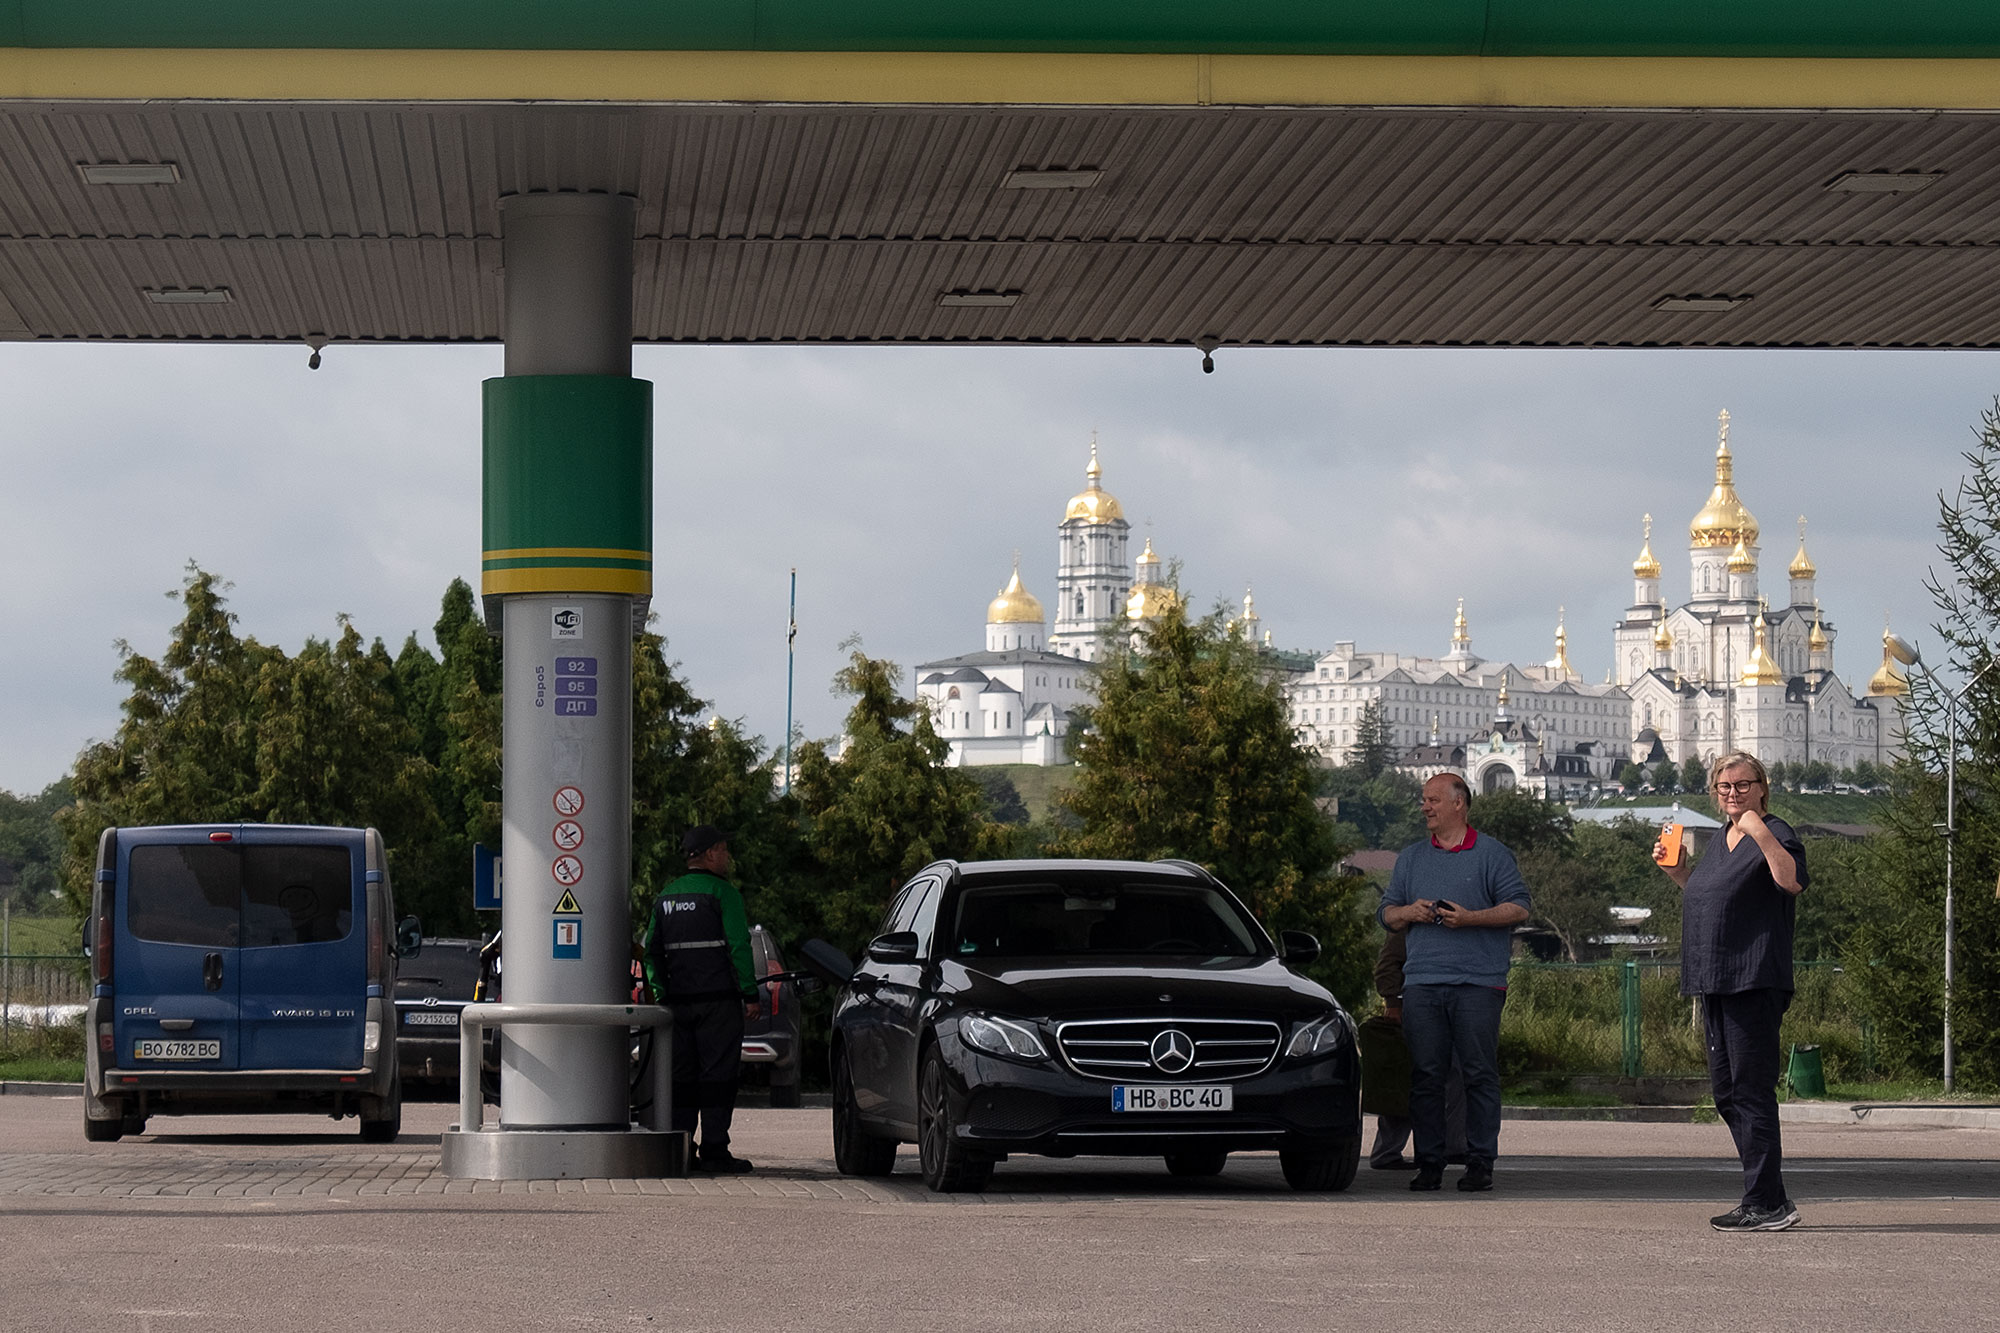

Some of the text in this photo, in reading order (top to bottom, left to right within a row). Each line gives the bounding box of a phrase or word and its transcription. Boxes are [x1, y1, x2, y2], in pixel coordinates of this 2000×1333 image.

[568, 661, 585, 672] 92
[568, 681, 585, 692] 95
[566, 701, 587, 713] ДП
[675, 902, 696, 911] WOG
[123, 1007, 156, 1015] OPEL
[143, 1043, 218, 1056] BO 6782 BC
[1130, 1088, 1223, 1108] HB BC 40
